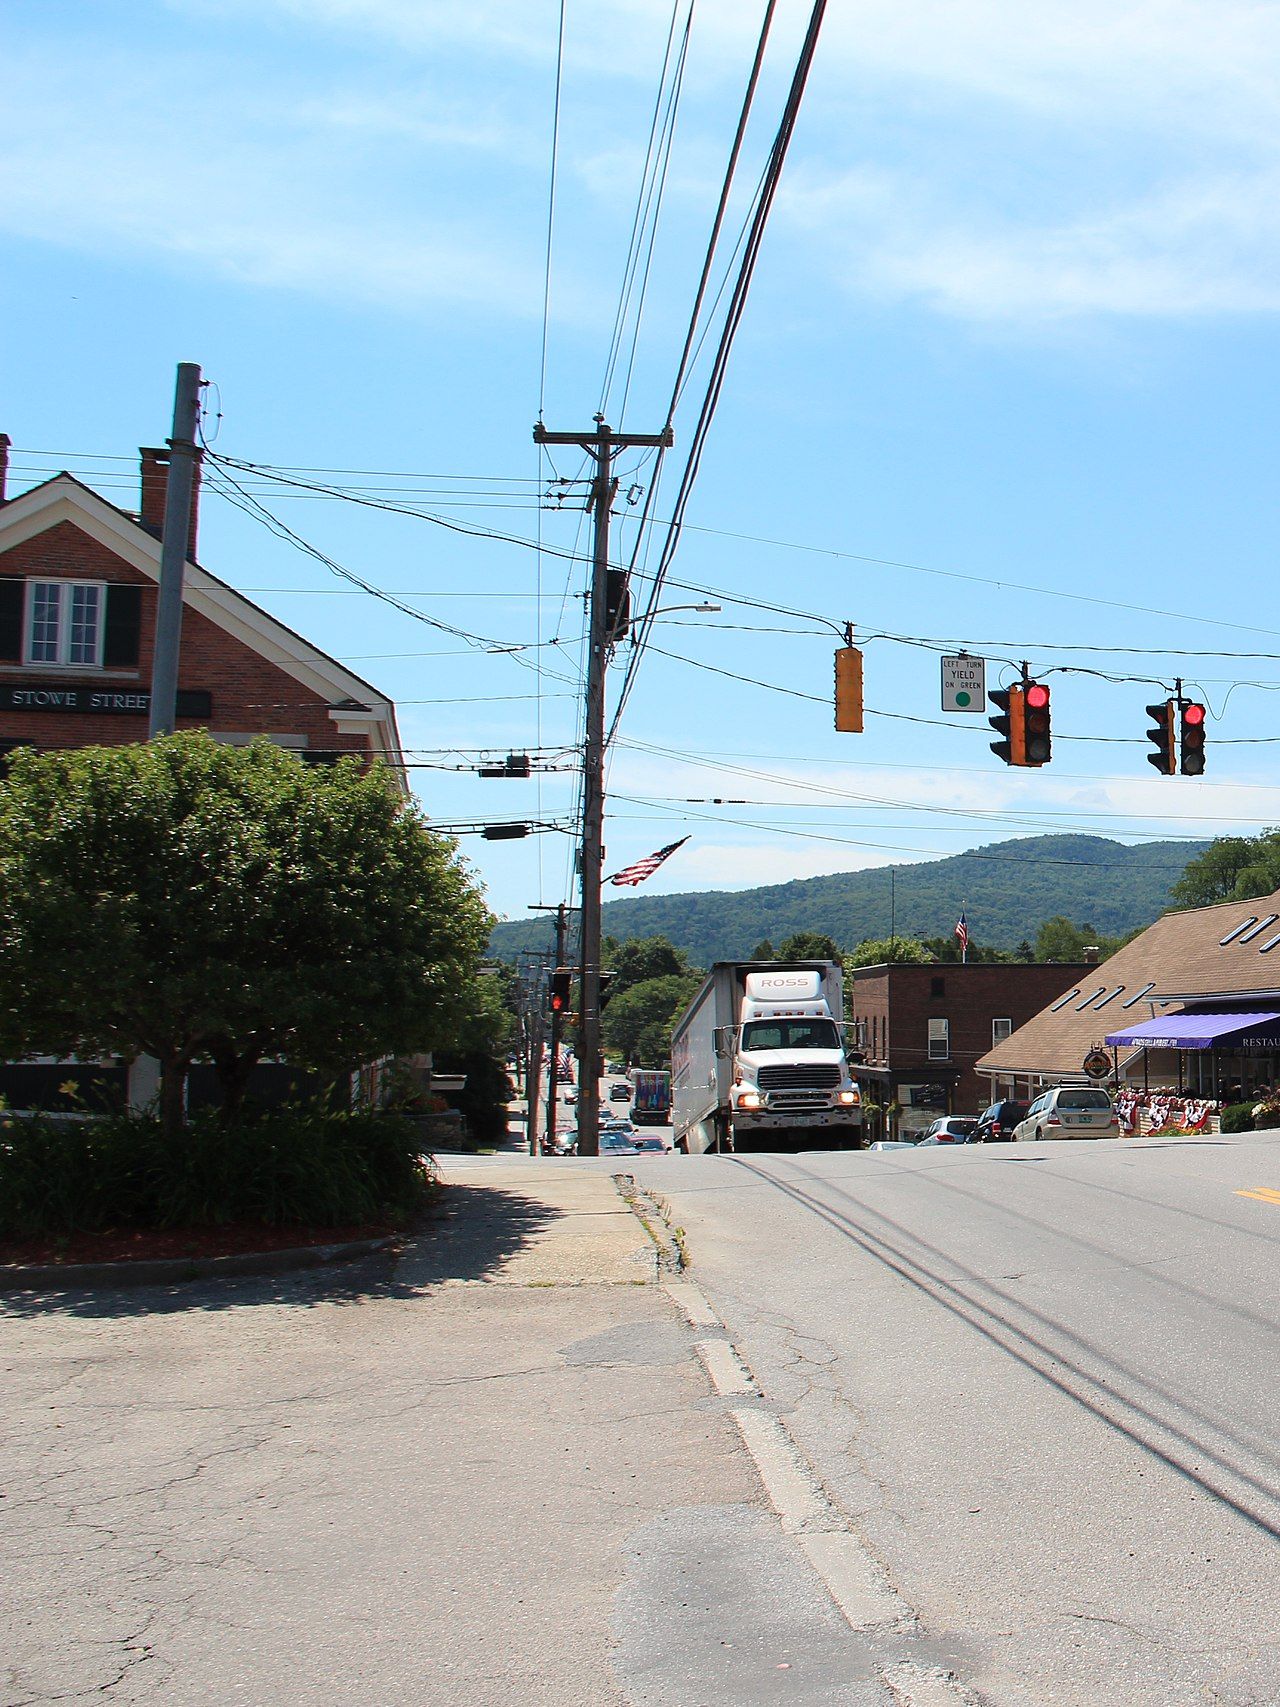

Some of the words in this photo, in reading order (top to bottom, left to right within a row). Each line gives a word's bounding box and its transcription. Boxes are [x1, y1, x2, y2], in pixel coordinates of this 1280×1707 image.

[943, 660, 959, 668] LEFT
[966, 661, 982, 669] TURN
[951, 670, 975, 680] YIELD
[960, 681, 981, 689] GREEN
[12, 690, 77, 707] STOWE
[761, 978, 808, 988] ROSS
